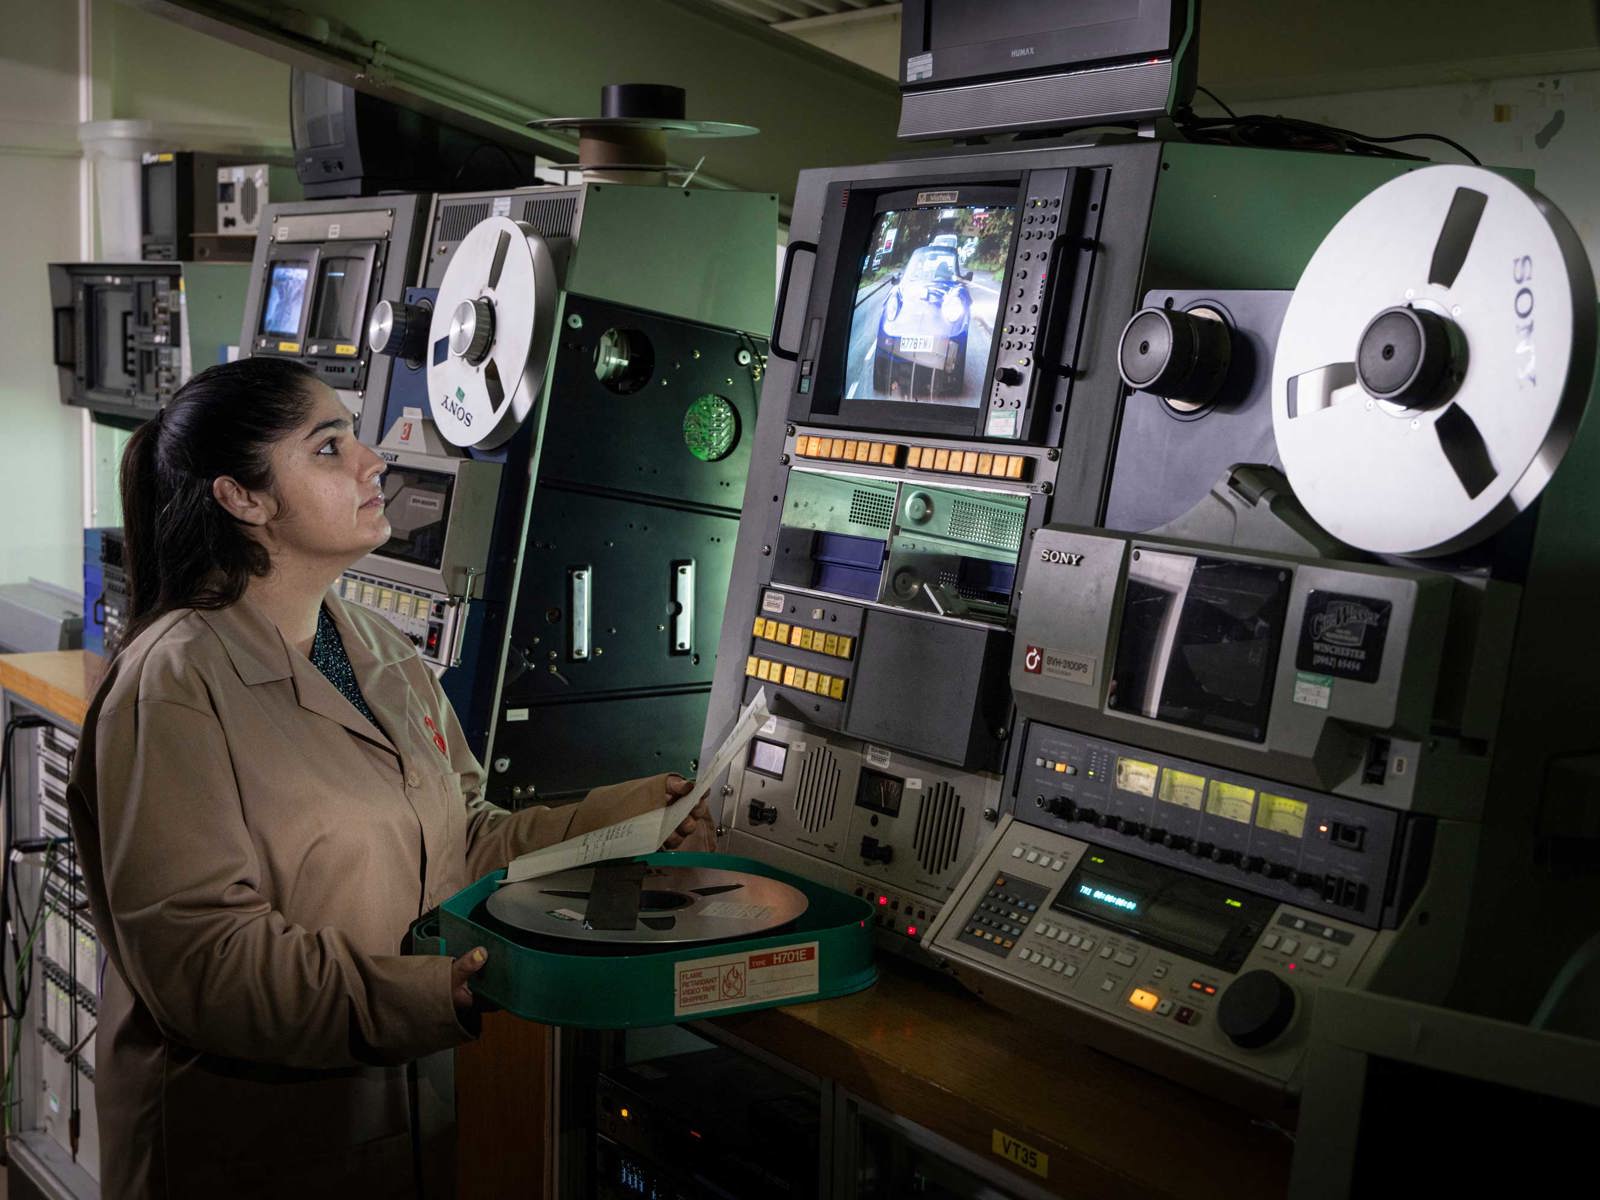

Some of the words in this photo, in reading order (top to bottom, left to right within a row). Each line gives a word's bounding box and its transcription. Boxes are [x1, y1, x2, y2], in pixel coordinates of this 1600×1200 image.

[1011, 48, 1034, 57] HUMAX
[1513, 255, 1536, 391] SONY
[441, 395, 473, 427] SONY
[1040, 549, 1083, 566] SONY
[1312, 641, 1367, 660] WINCHESTER
[752, 959, 767, 967] TYPE
[773, 949, 807, 964] H701E
[682, 971, 703, 979] FLAME
[682, 977, 718, 987] RETARDANT
[682, 985, 700, 995] VIDEO
[701, 983, 717, 992] TAPE
[682, 993, 709, 1003] SHIPPER
[1002, 1135, 1037, 1168] VT35
